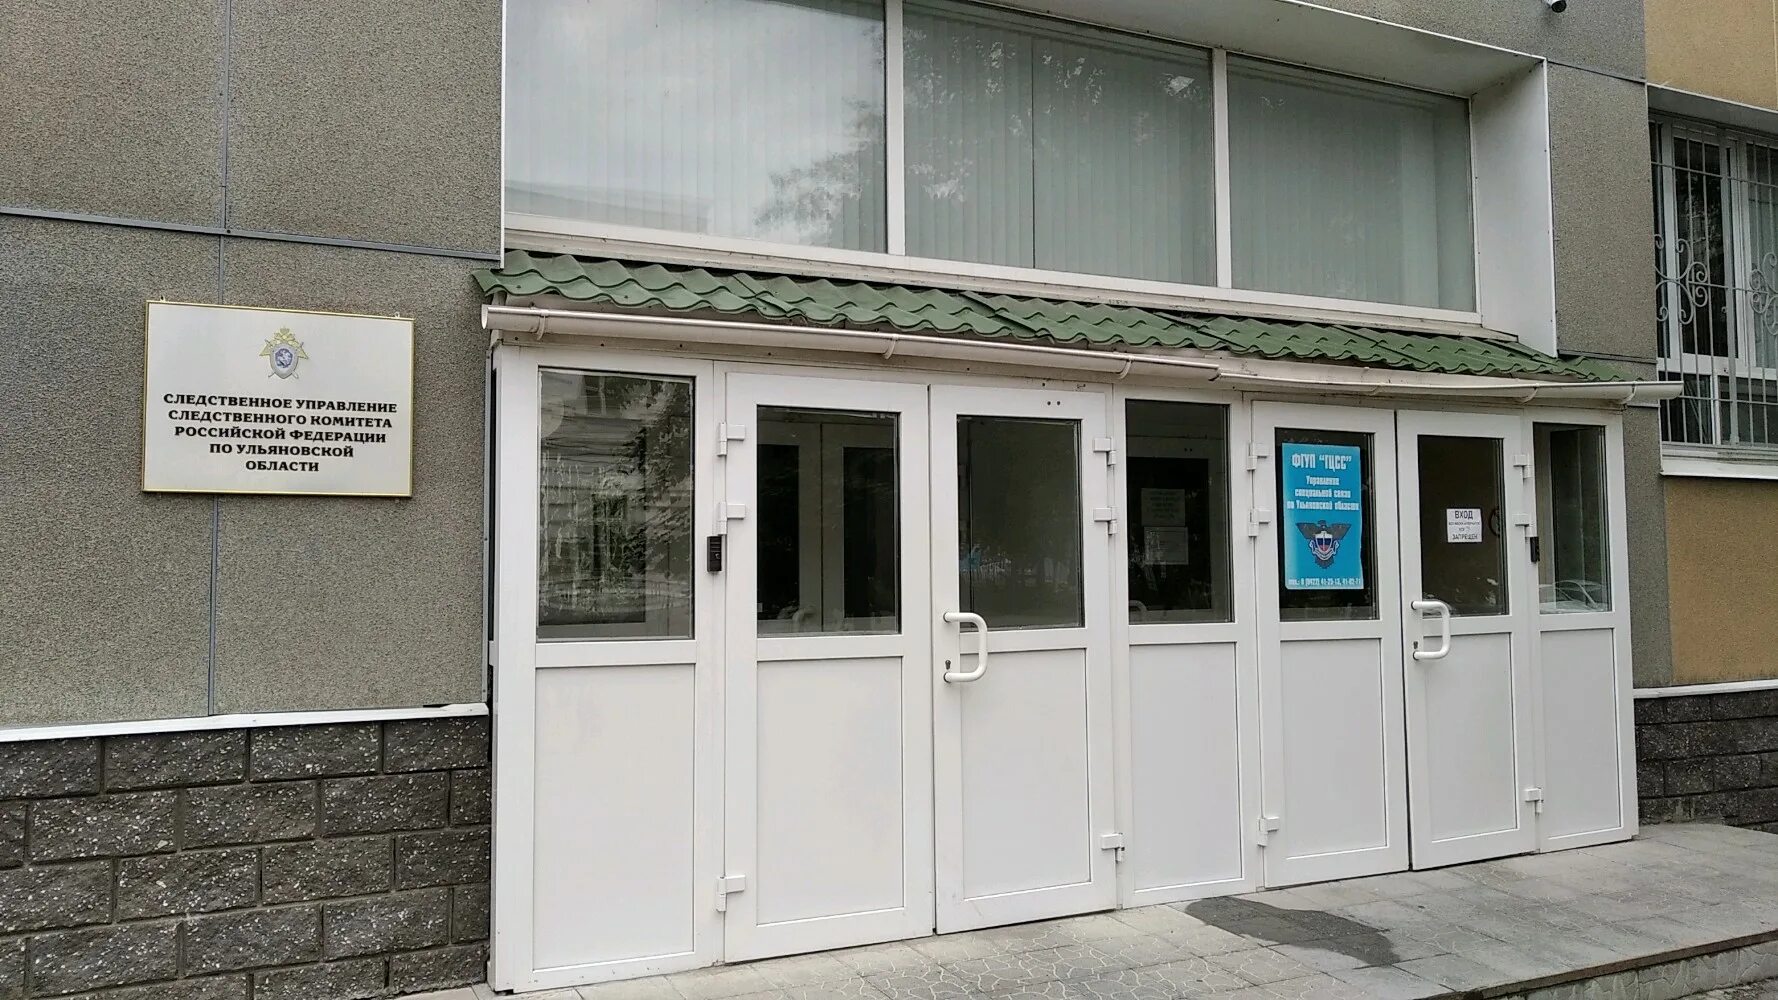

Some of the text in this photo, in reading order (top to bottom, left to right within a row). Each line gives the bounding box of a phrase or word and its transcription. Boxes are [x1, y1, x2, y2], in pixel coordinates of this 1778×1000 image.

[163, 393, 398, 413] СЛЕДСТВЕННОЕ УПРАВЛЕНИЕ
[168, 409, 393, 428] СЛЕДСТВЕННОГО КОМИТЕТА
[175, 426, 387, 444] РОССИЙСКОЙ ФЕДЕРАЦИИ
[209, 443, 354, 457] ПО УЛЬЯНОВСКОЙ
[245, 460, 320, 472] ОБЛАСТИ
[1291, 453, 1316, 468] ФГУП
[1306, 475, 1340, 486] Управление
[1294, 488, 1333, 499] специальной
[1455, 510, 1473, 520] ВХОД
